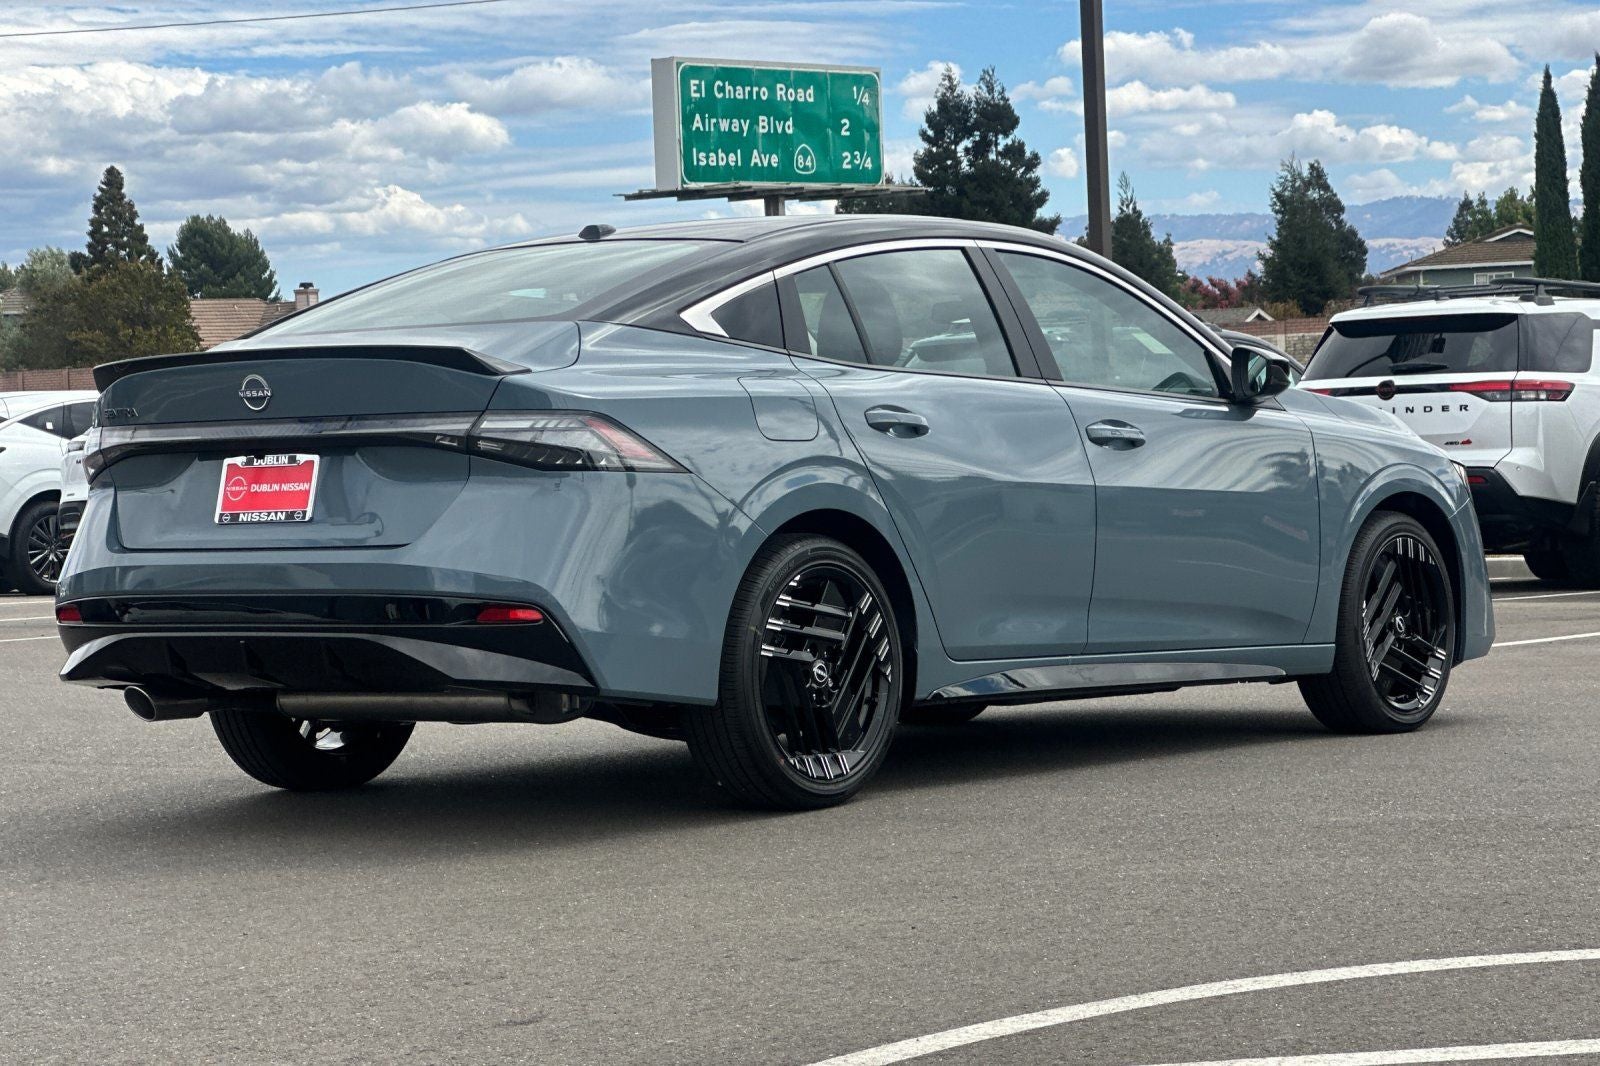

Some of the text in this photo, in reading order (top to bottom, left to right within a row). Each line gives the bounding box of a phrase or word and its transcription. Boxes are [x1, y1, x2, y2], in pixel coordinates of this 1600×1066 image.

[690, 79, 705, 98] El
[714, 81, 768, 100] Charro
[776, 84, 814, 102] Road
[692, 113, 850, 137] Airway Blvd 2
[692, 147, 742, 167] Isabel
[750, 149, 779, 167] Ave
[797, 155, 813, 168] 84
[239, 389, 272, 398] NISSAN
[251, 482, 309, 492] DUBLIN NISSAN
[239, 512, 285, 521] NISSAN
